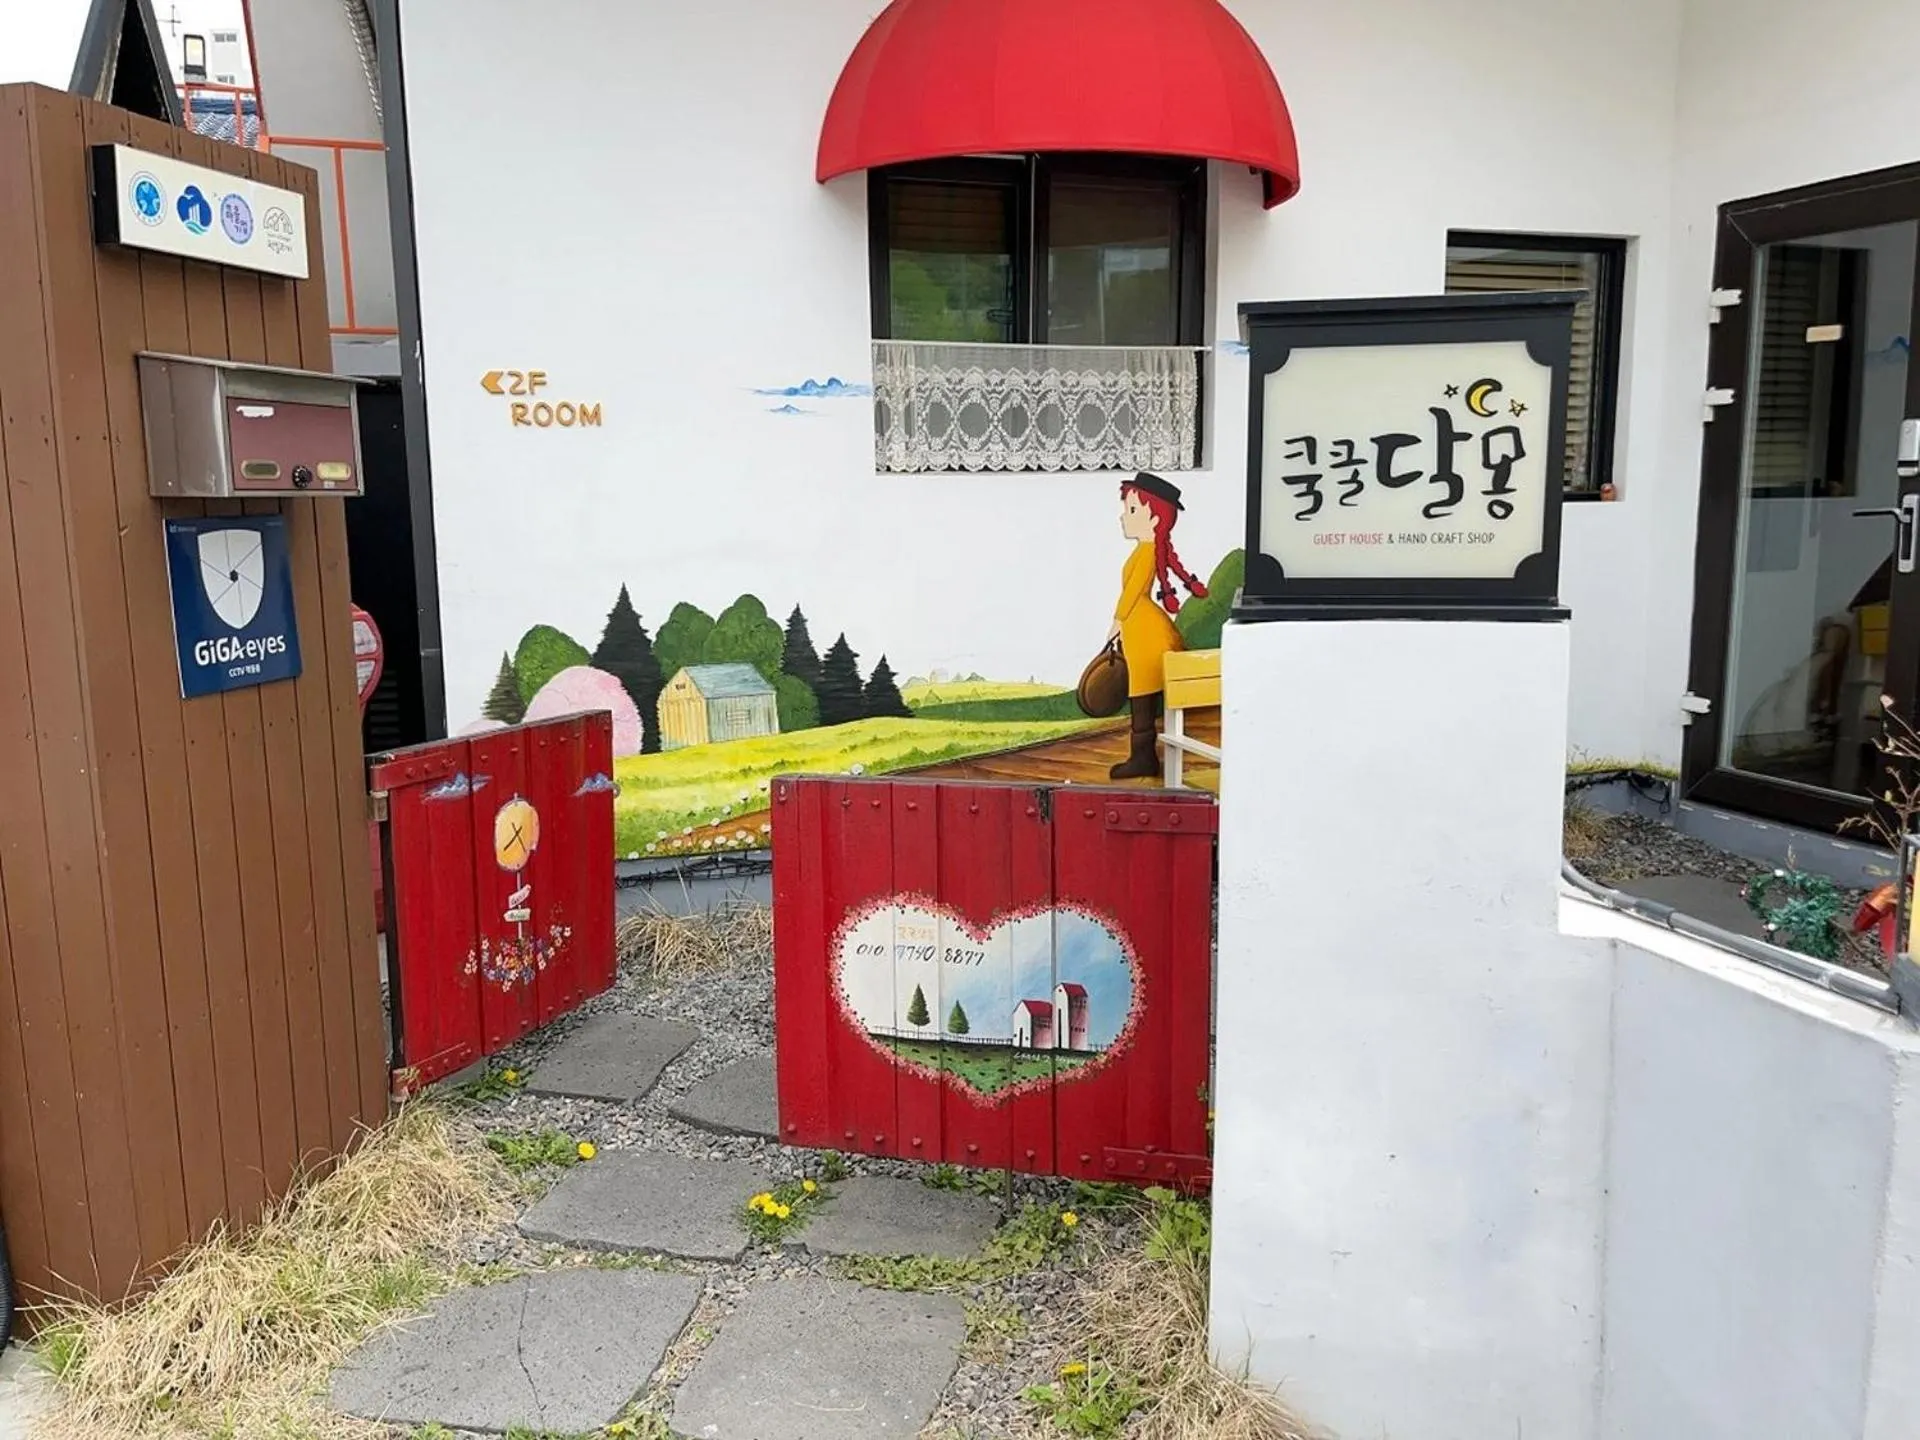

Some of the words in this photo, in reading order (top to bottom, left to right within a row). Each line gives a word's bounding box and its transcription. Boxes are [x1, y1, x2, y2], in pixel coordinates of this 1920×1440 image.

[507, 371, 547, 395] 2F
[511, 402, 602, 427] ROOM
[1313, 533, 1346, 545] GUEST
[1349, 532, 1384, 544] HOUSE
[1386, 533, 1395, 544] &
[1398, 532, 1428, 544] HAND
[1430, 532, 1465, 544] CRAFT
[1467, 531, 1496, 544] SHOP
[856, 943, 885, 957] 010
[943, 947, 986, 967] 8877
